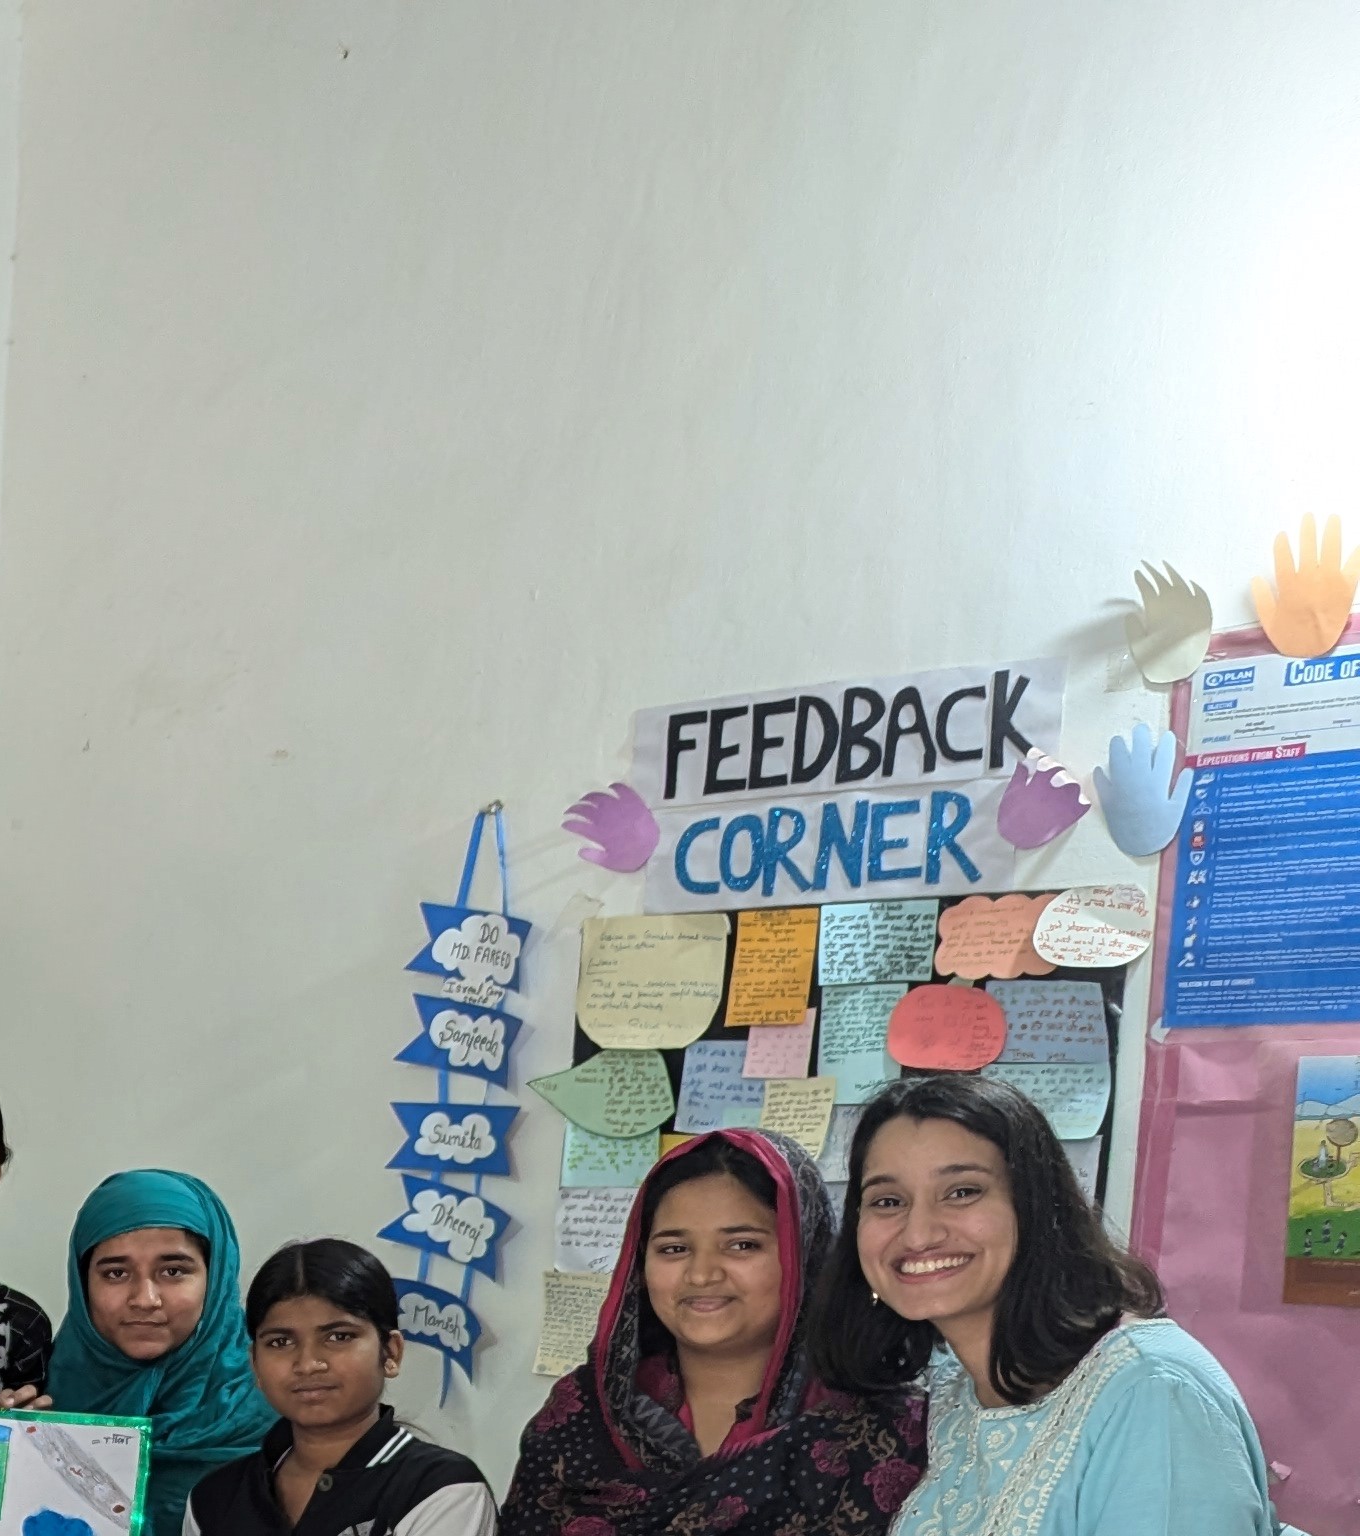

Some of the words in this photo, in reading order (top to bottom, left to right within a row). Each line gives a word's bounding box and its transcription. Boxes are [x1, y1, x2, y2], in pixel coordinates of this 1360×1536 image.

[1224, 670, 1253, 682] PLAN
[663, 669, 1037, 800] FEEDBACK
[675, 790, 982, 898] CORNER
[479, 923, 500, 945] DO
[451, 942, 471, 959] MD.
[474, 945, 512, 969] FAREED
[438, 1019, 499, 1062] Sanjeeda
[428, 1123, 482, 1150] Sunita
[431, 1203, 485, 1255] Dheeraj
